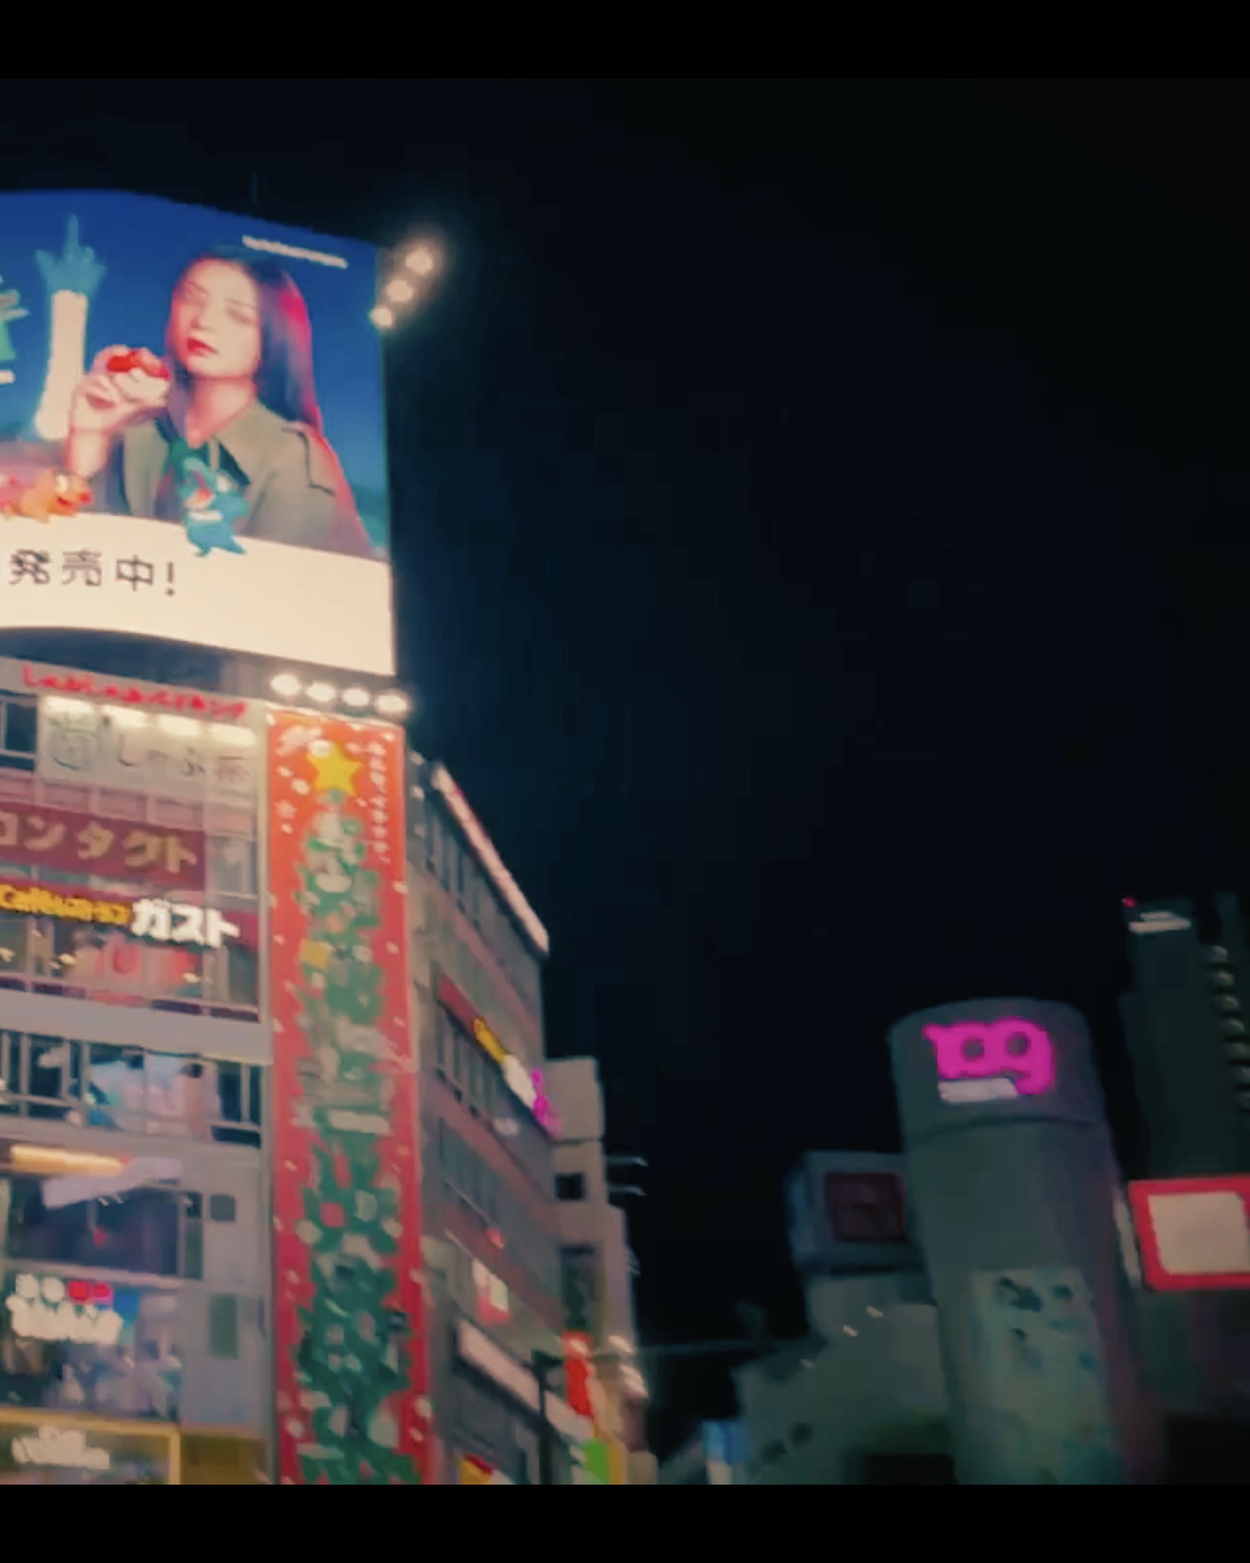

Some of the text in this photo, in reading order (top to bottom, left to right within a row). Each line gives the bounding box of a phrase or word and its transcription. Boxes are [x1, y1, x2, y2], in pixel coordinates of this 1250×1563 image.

[131, 898, 240, 949] ガスト
[922, 1015, 1055, 1096] 109
